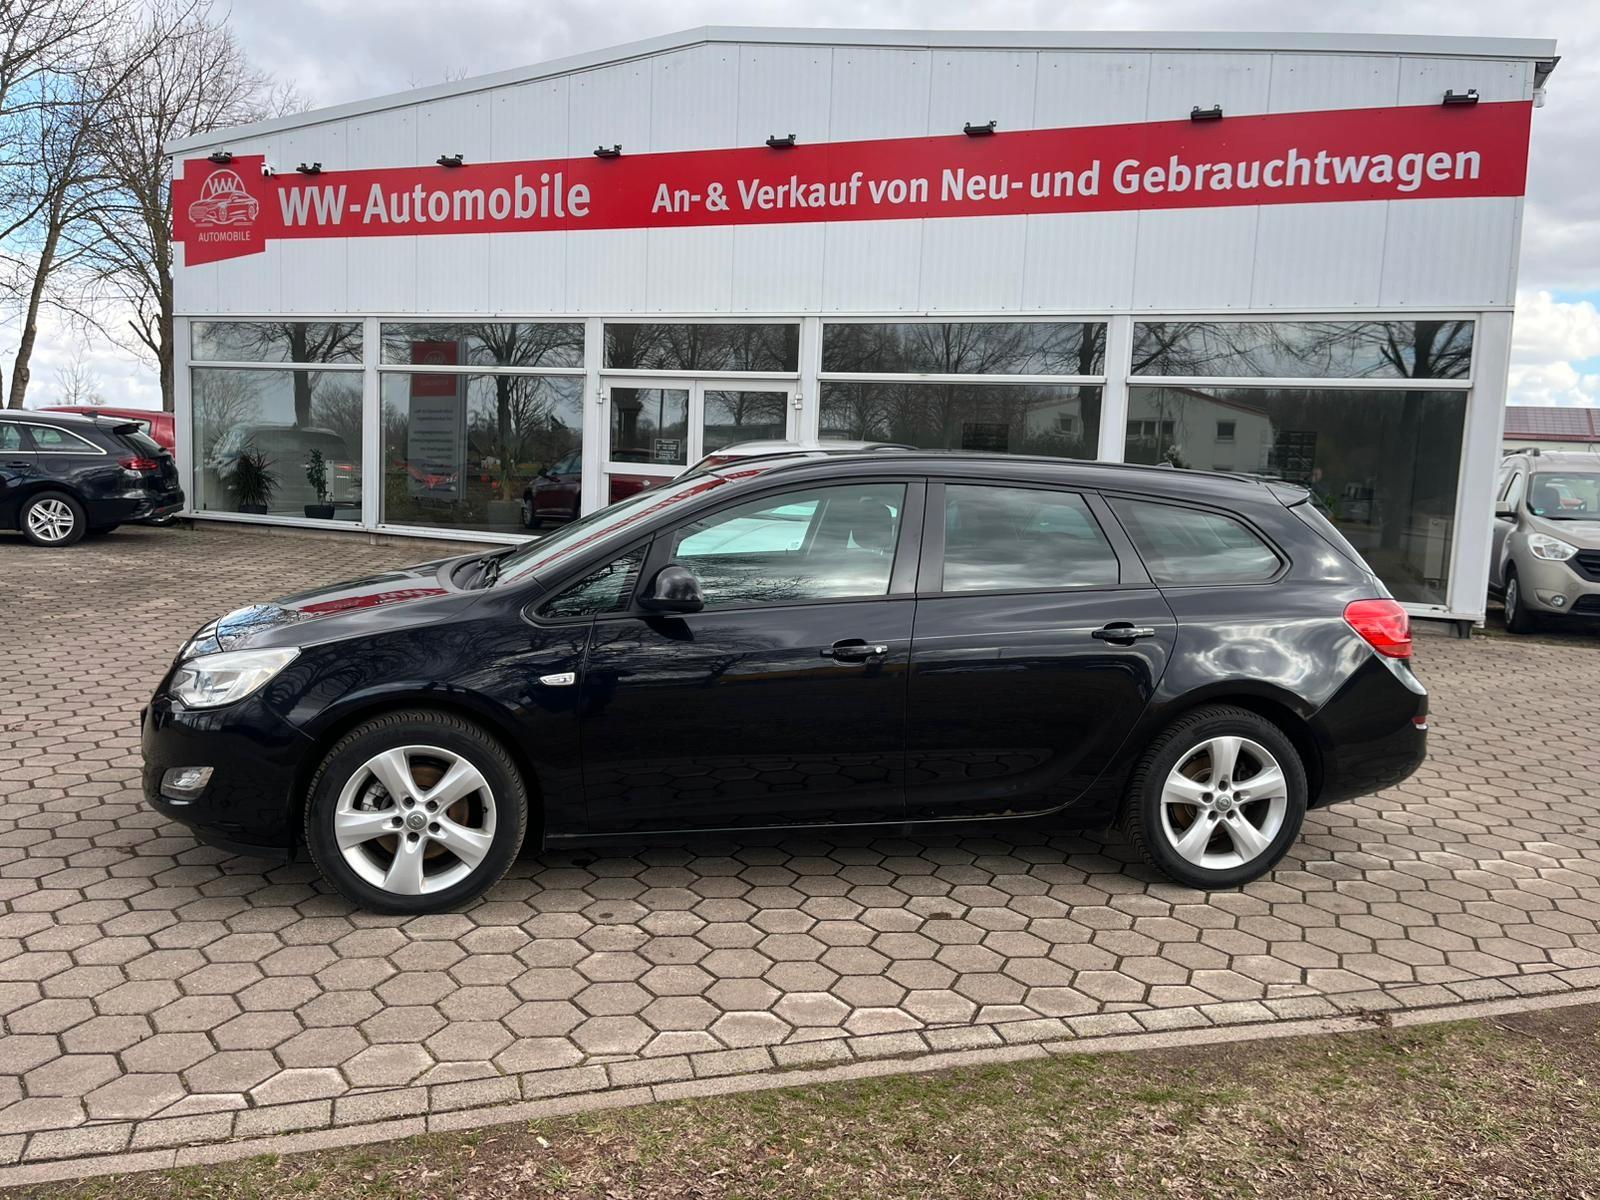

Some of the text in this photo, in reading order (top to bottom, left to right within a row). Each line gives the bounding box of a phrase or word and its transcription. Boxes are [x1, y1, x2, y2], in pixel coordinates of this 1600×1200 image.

[277, 171, 591, 227] WW-Automobile
[737, 171, 864, 210] Verkauf
[868, 177, 929, 205] von
[940, 167, 1024, 202] Neu-
[1030, 159, 1100, 199] und
[1112, 148, 1481, 194] Gebrauchtwagen
[198, 230, 252, 243] AUTOMOBILE
